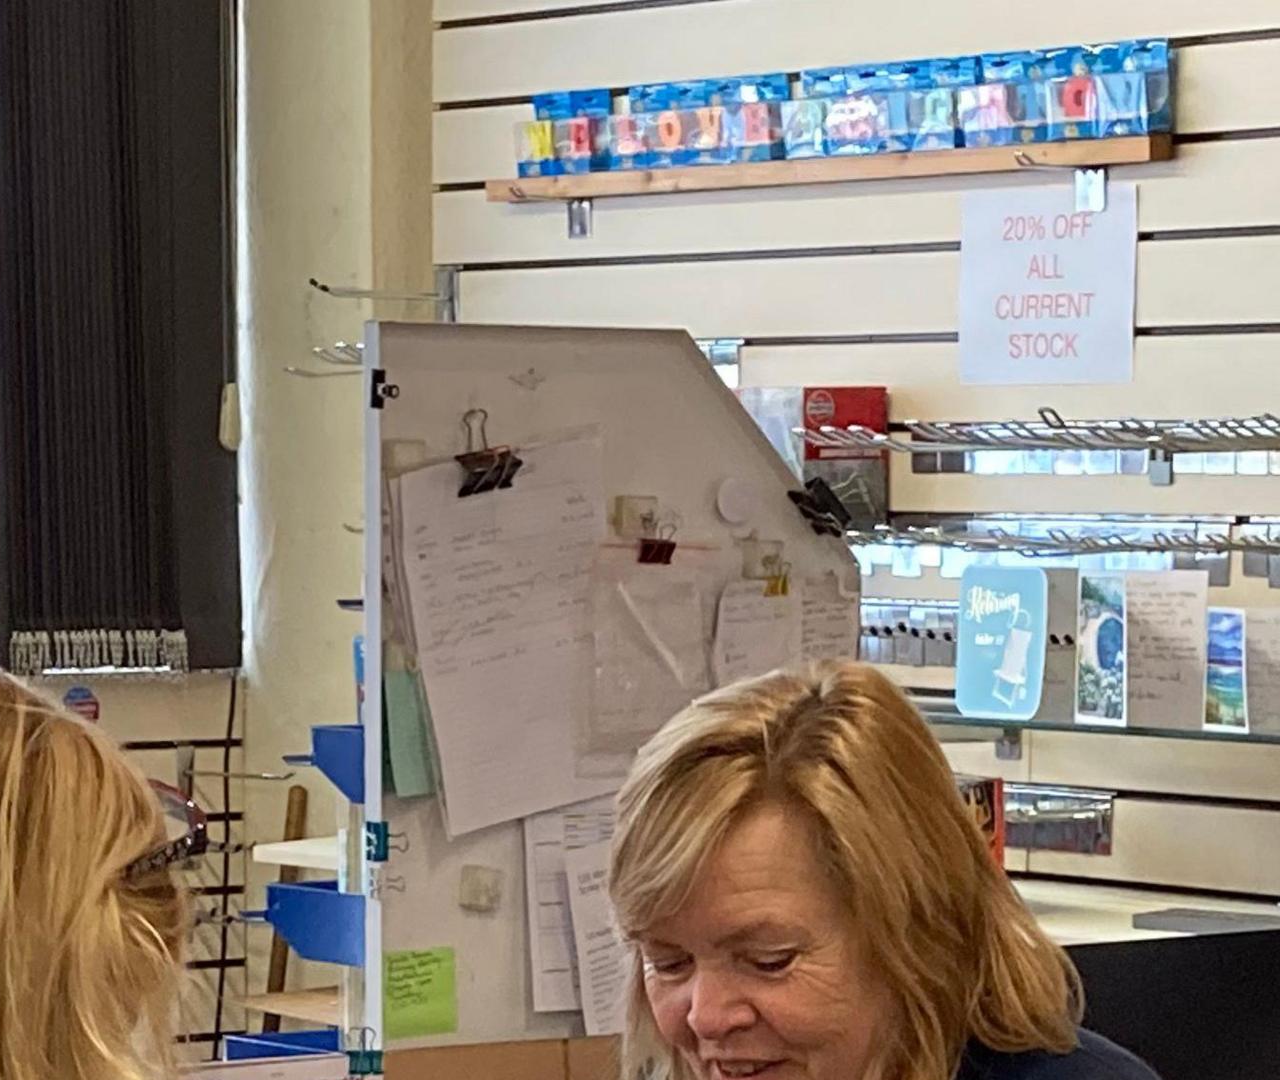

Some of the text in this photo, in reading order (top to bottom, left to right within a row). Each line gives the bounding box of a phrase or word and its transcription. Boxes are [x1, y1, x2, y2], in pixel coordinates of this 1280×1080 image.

[1002, 212, 1093, 241] 20% OFF
[1026, 253, 1065, 280] ALL
[995, 292, 1096, 320] CURRENT
[1008, 332, 1079, 360] STOCK
